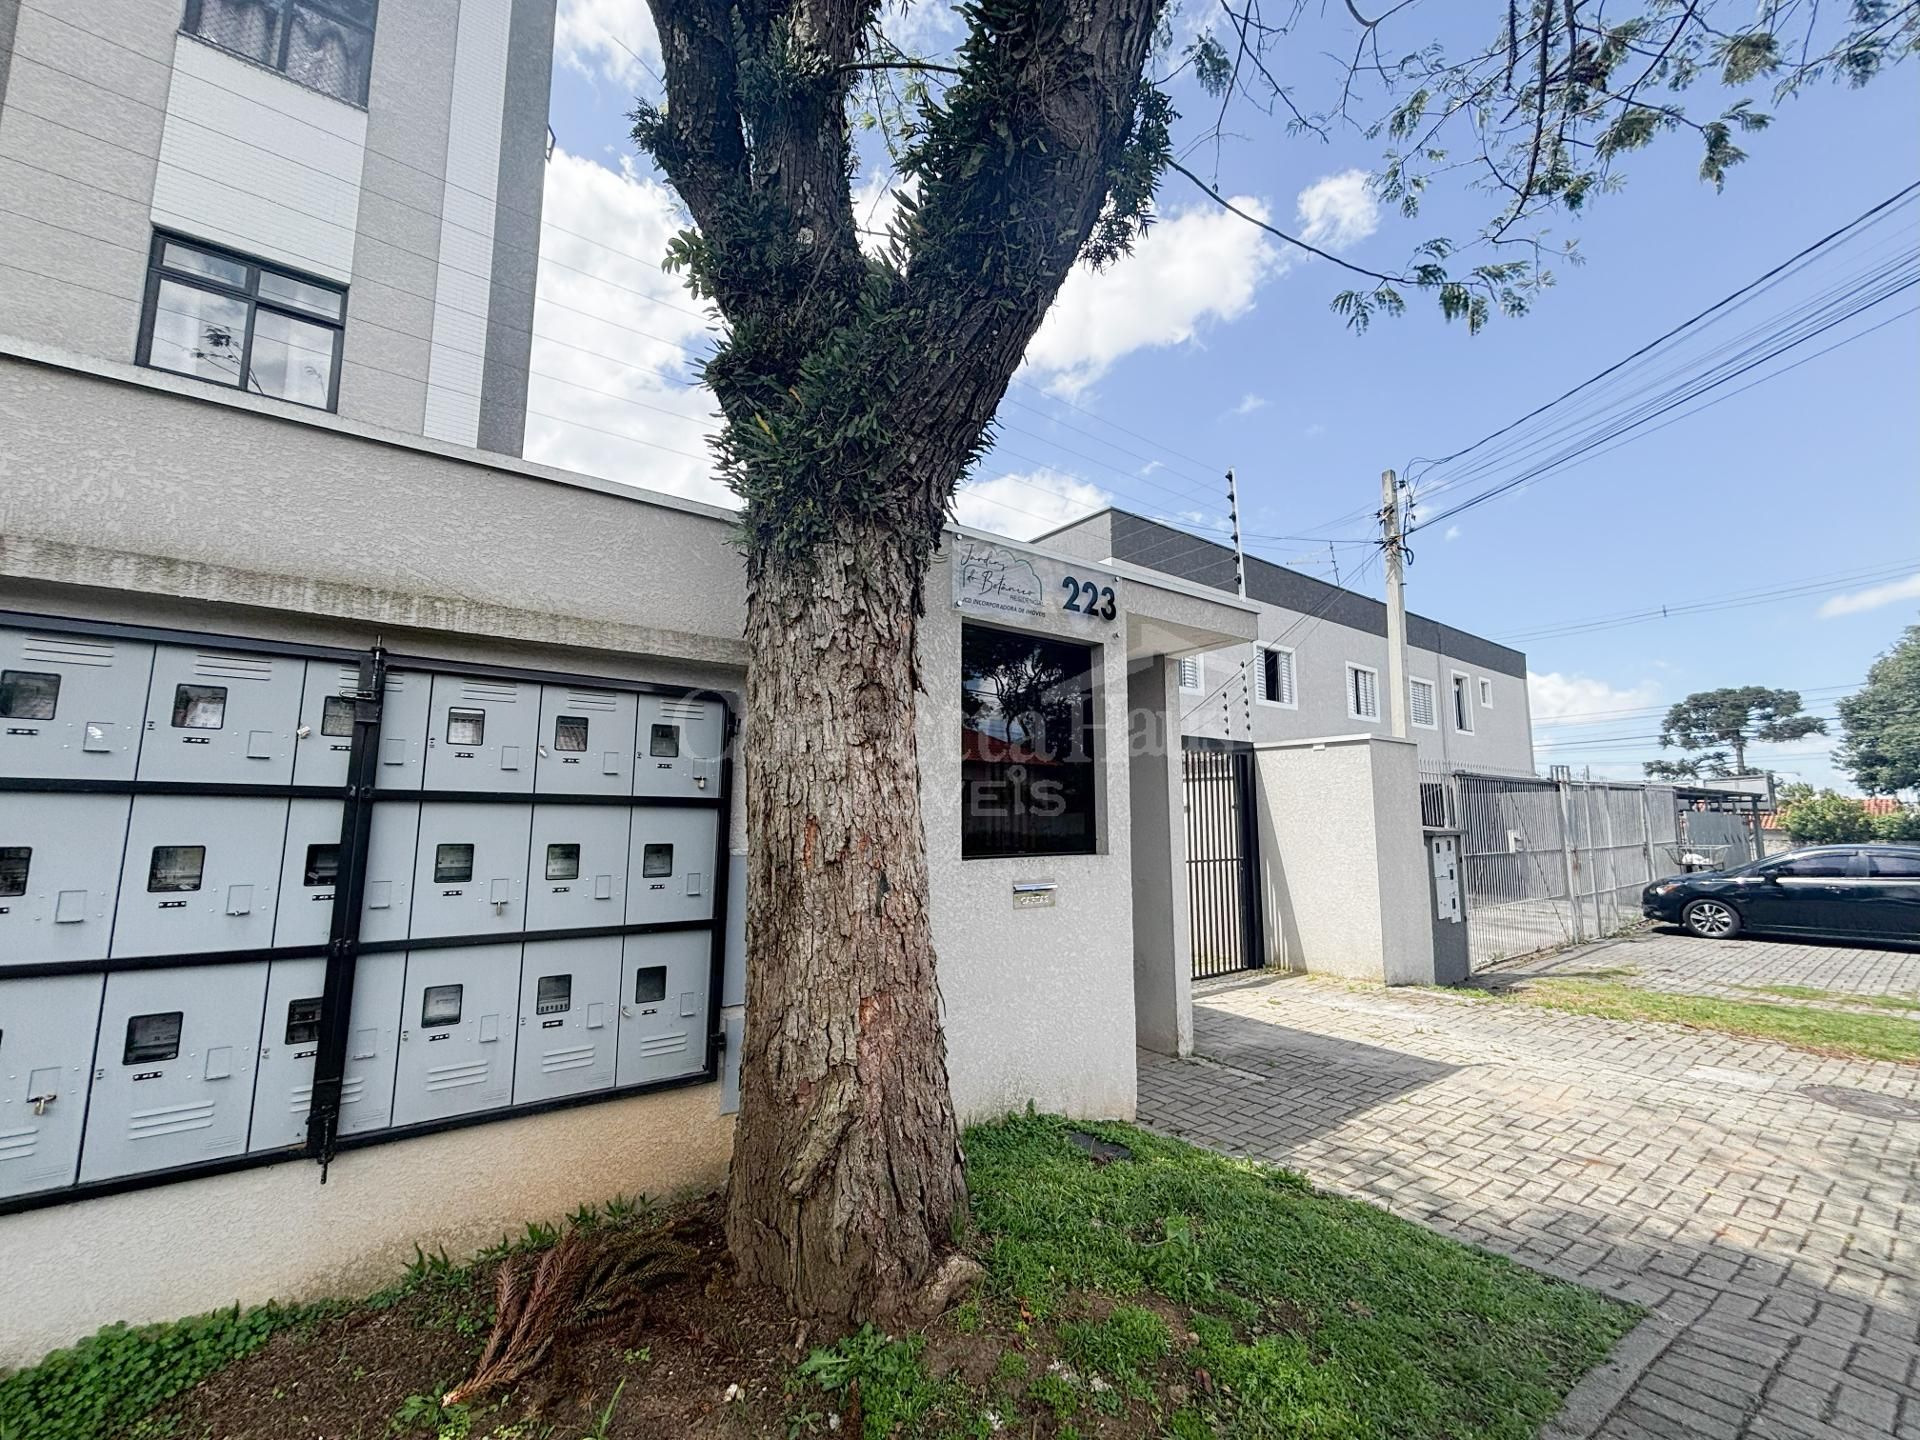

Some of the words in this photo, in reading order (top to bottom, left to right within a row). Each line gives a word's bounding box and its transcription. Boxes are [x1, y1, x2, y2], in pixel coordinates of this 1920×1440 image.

[972, 598, 1017, 612] INCORPORADORA
[1009, 594, 1045, 607] RESIDENCIAL
[1062, 575, 1117, 621] 223
